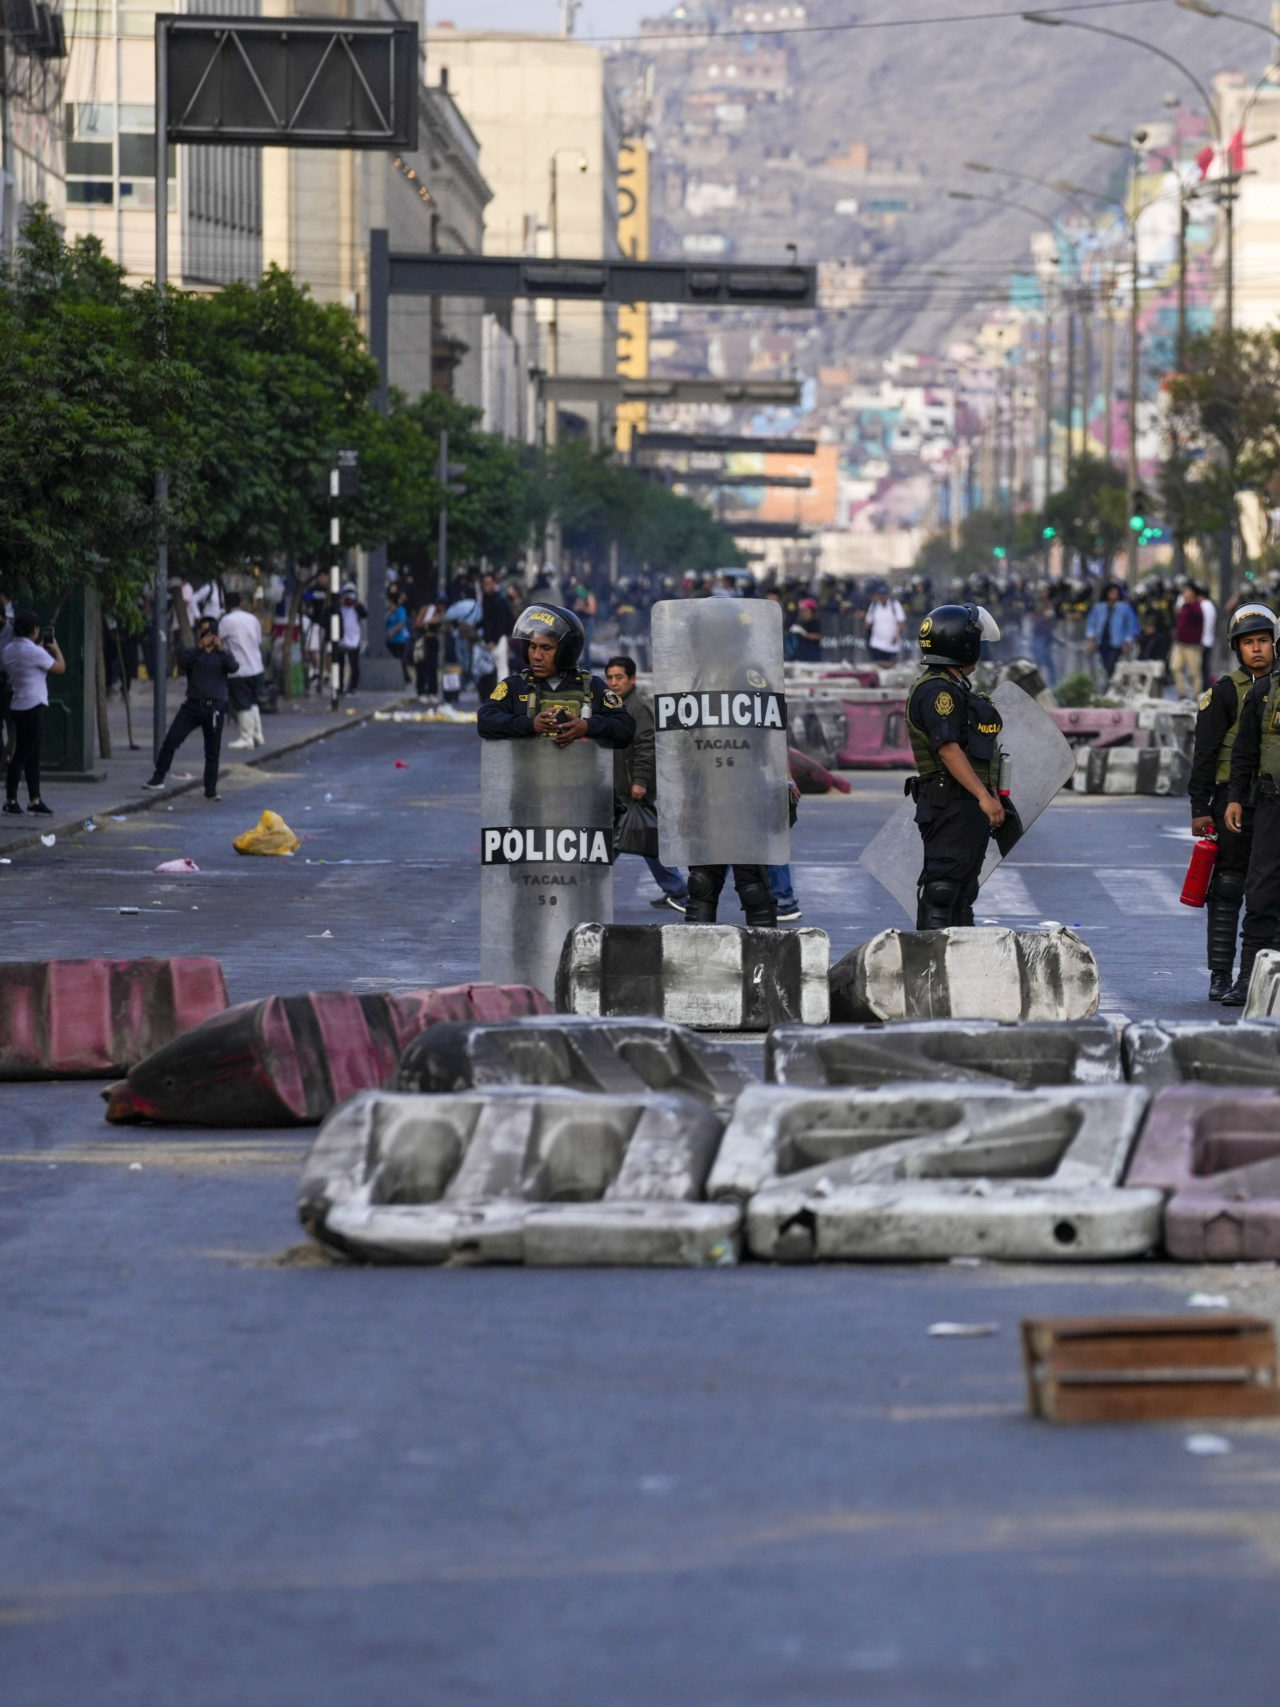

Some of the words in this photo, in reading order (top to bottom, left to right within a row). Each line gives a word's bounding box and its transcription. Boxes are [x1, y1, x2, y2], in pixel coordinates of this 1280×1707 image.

[658, 692, 783, 729] POLICIA
[694, 739, 751, 750] TACALA
[484, 828, 610, 863] POLICIA
[522, 874, 578, 886] TACALA
